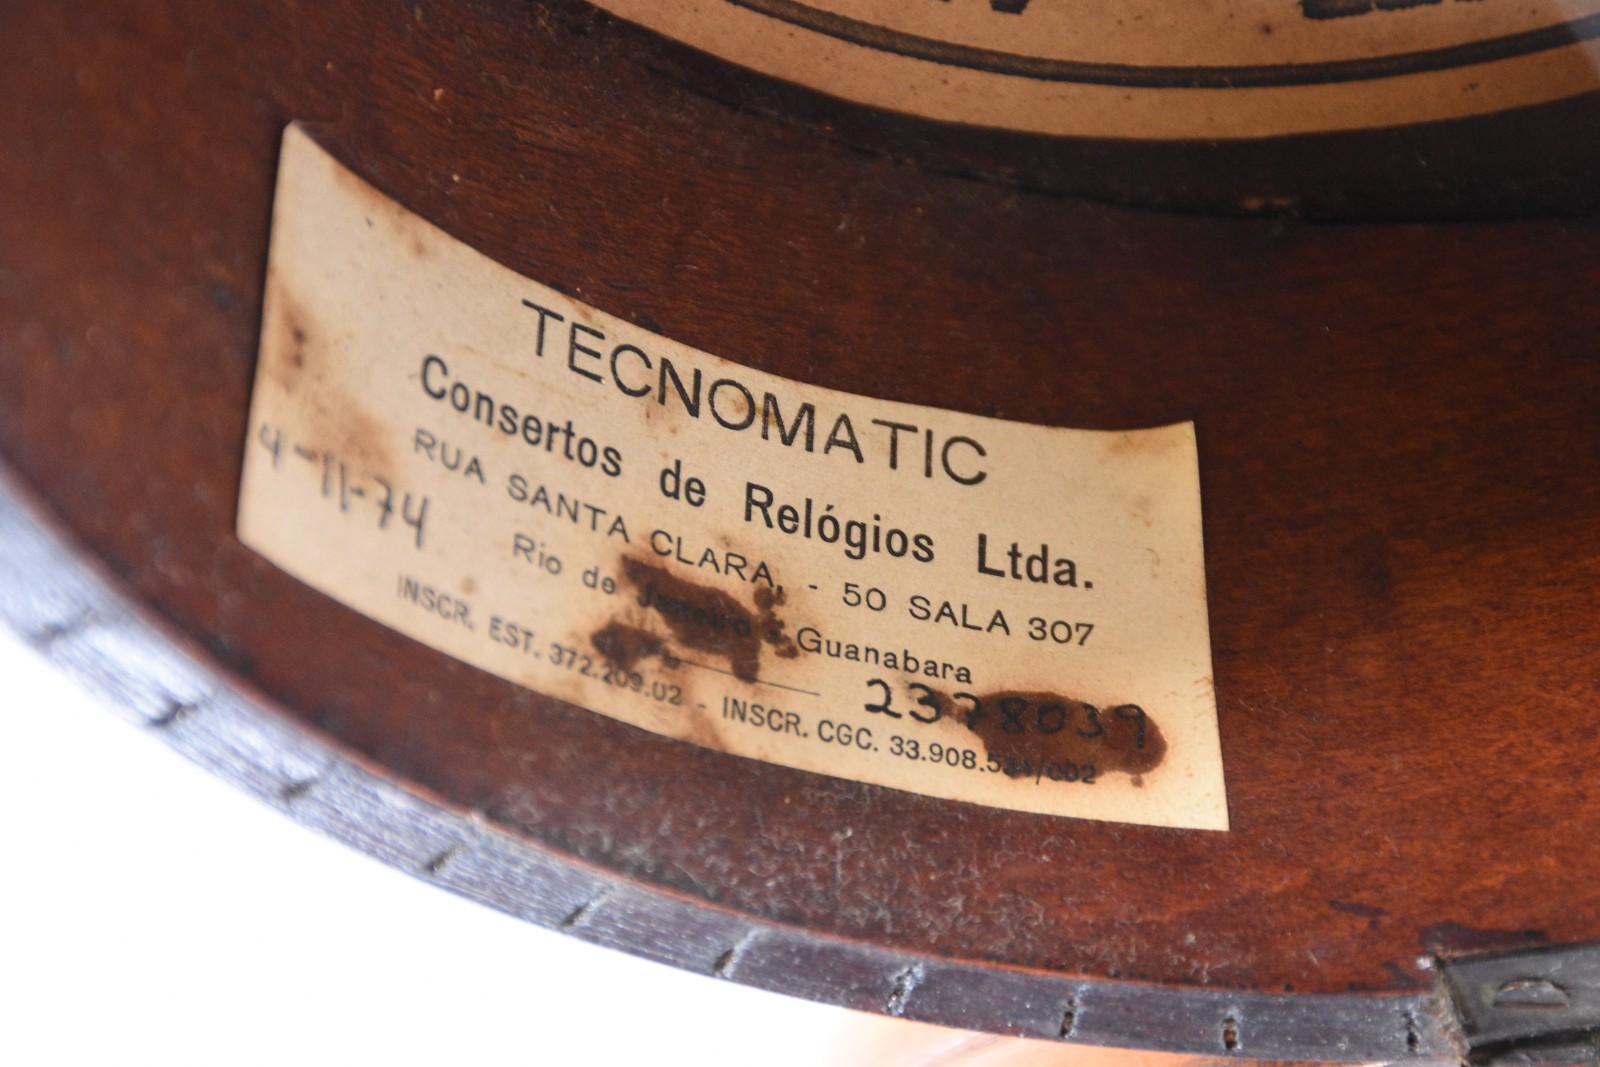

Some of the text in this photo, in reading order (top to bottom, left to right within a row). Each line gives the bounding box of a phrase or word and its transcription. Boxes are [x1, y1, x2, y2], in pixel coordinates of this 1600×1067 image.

[421, 354, 1094, 590] Consertos de Relógios Ltda.
[522, 299, 988, 486] TECNOMATIC
[414, 428, 486, 485] RUA
[507, 473, 630, 543] SANTA
[649, 529, 784, 592] CLARA,
[842, 583, 887, 612] 50
[908, 595, 1011, 636] SALA
[1028, 616, 1095, 647] 307
[513, 533, 563, 575] Rio
[582, 566, 616, 595] de
[796, 626, 972, 685] Guanabara
[397, 576, 474, 630] INSCR.
[488, 616, 541, 659] EST.
[722, 696, 809, 738] INSCR.
[817, 719, 879, 753] CGC.
